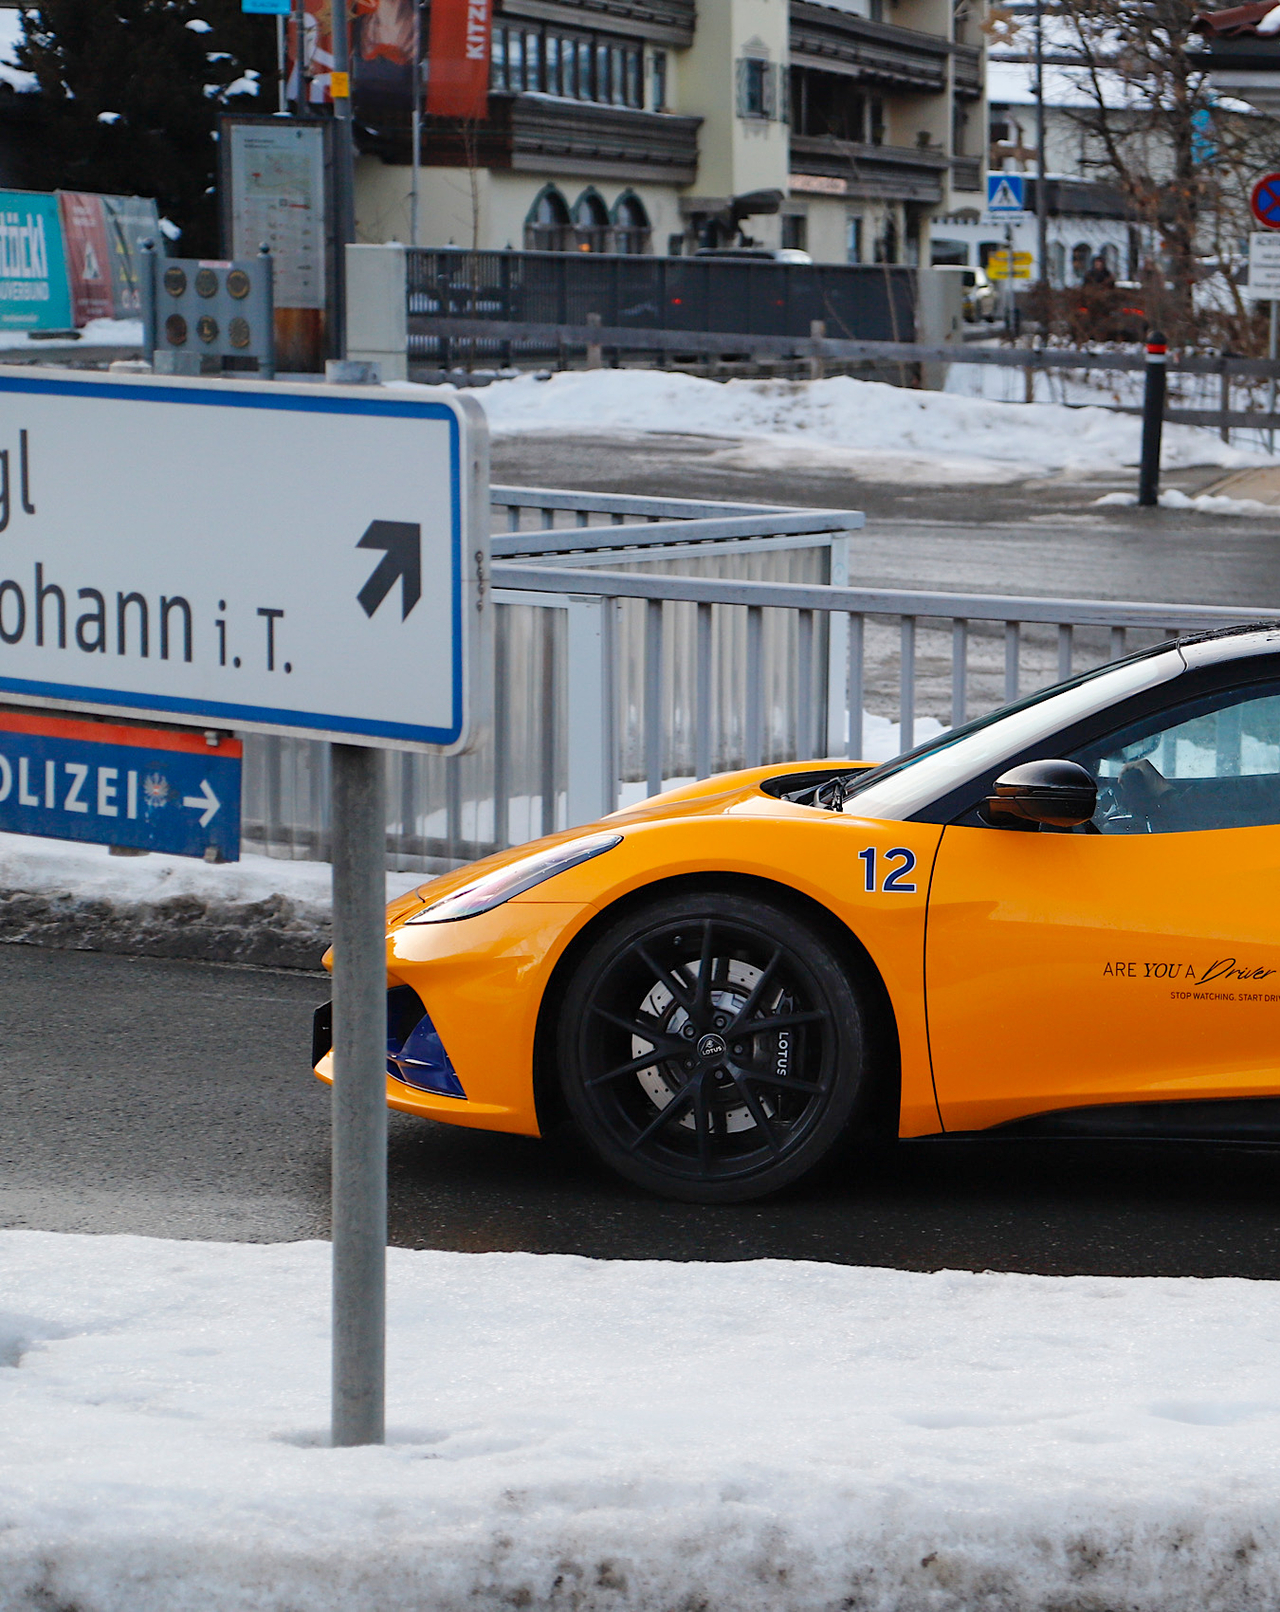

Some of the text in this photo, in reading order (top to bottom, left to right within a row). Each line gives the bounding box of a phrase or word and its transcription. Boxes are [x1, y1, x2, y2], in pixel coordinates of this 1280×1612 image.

[0, 562, 192, 663] ohann
[858, 846, 917, 893] 12
[1103, 962, 1137, 977] ARE
[1143, 962, 1183, 979] YOU
[1184, 964, 1196, 979] A
[1194, 958, 1277, 986] Driver
[1170, 991, 1192, 1000] STOP
[1193, 992, 1237, 1002] WATCHING.
[1238, 993, 1263, 1002] START
[702, 1046, 722, 1056] LOTUS
[776, 1031, 789, 1076] LOTUS
